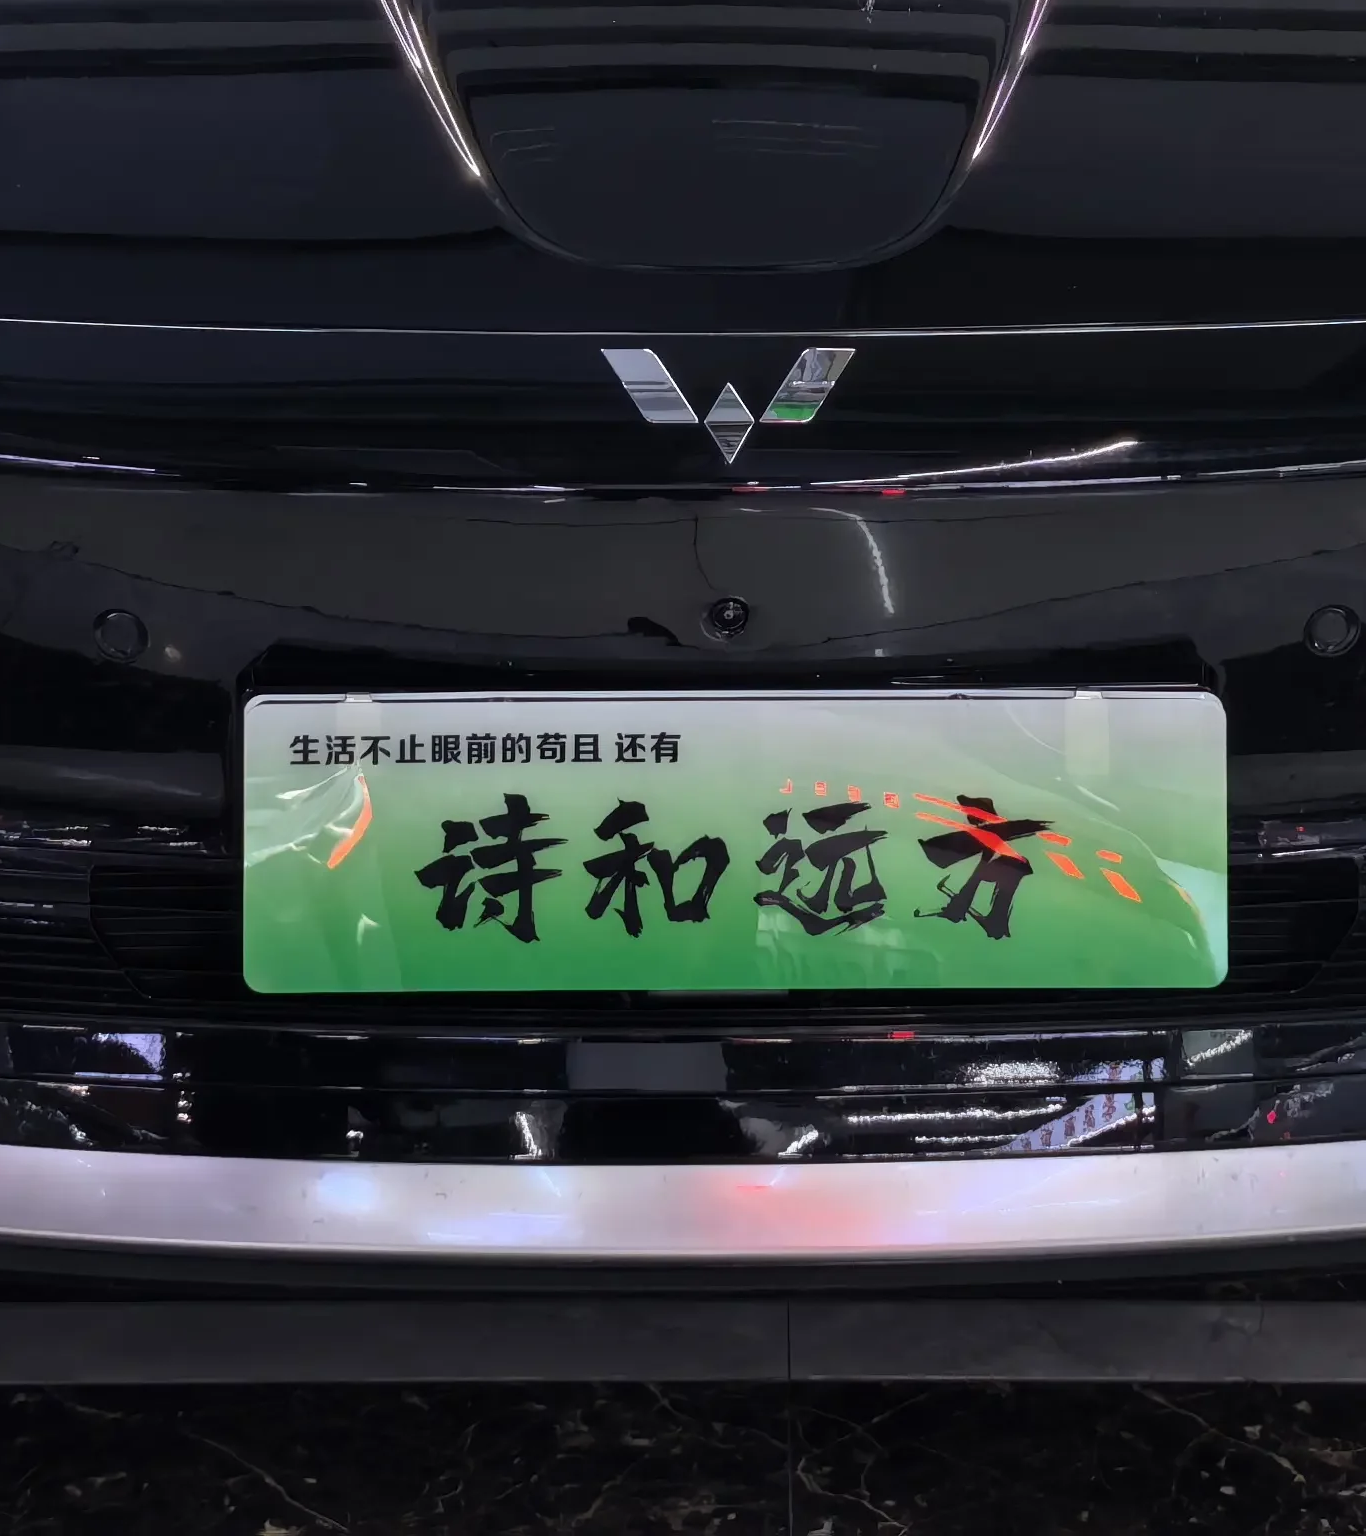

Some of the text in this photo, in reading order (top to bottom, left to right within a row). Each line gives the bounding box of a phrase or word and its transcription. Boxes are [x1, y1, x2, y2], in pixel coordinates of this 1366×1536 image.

[289, 732, 681, 765] 生活不止眼前的苟且 还有
[414, 792, 1056, 943] 诗和远方
